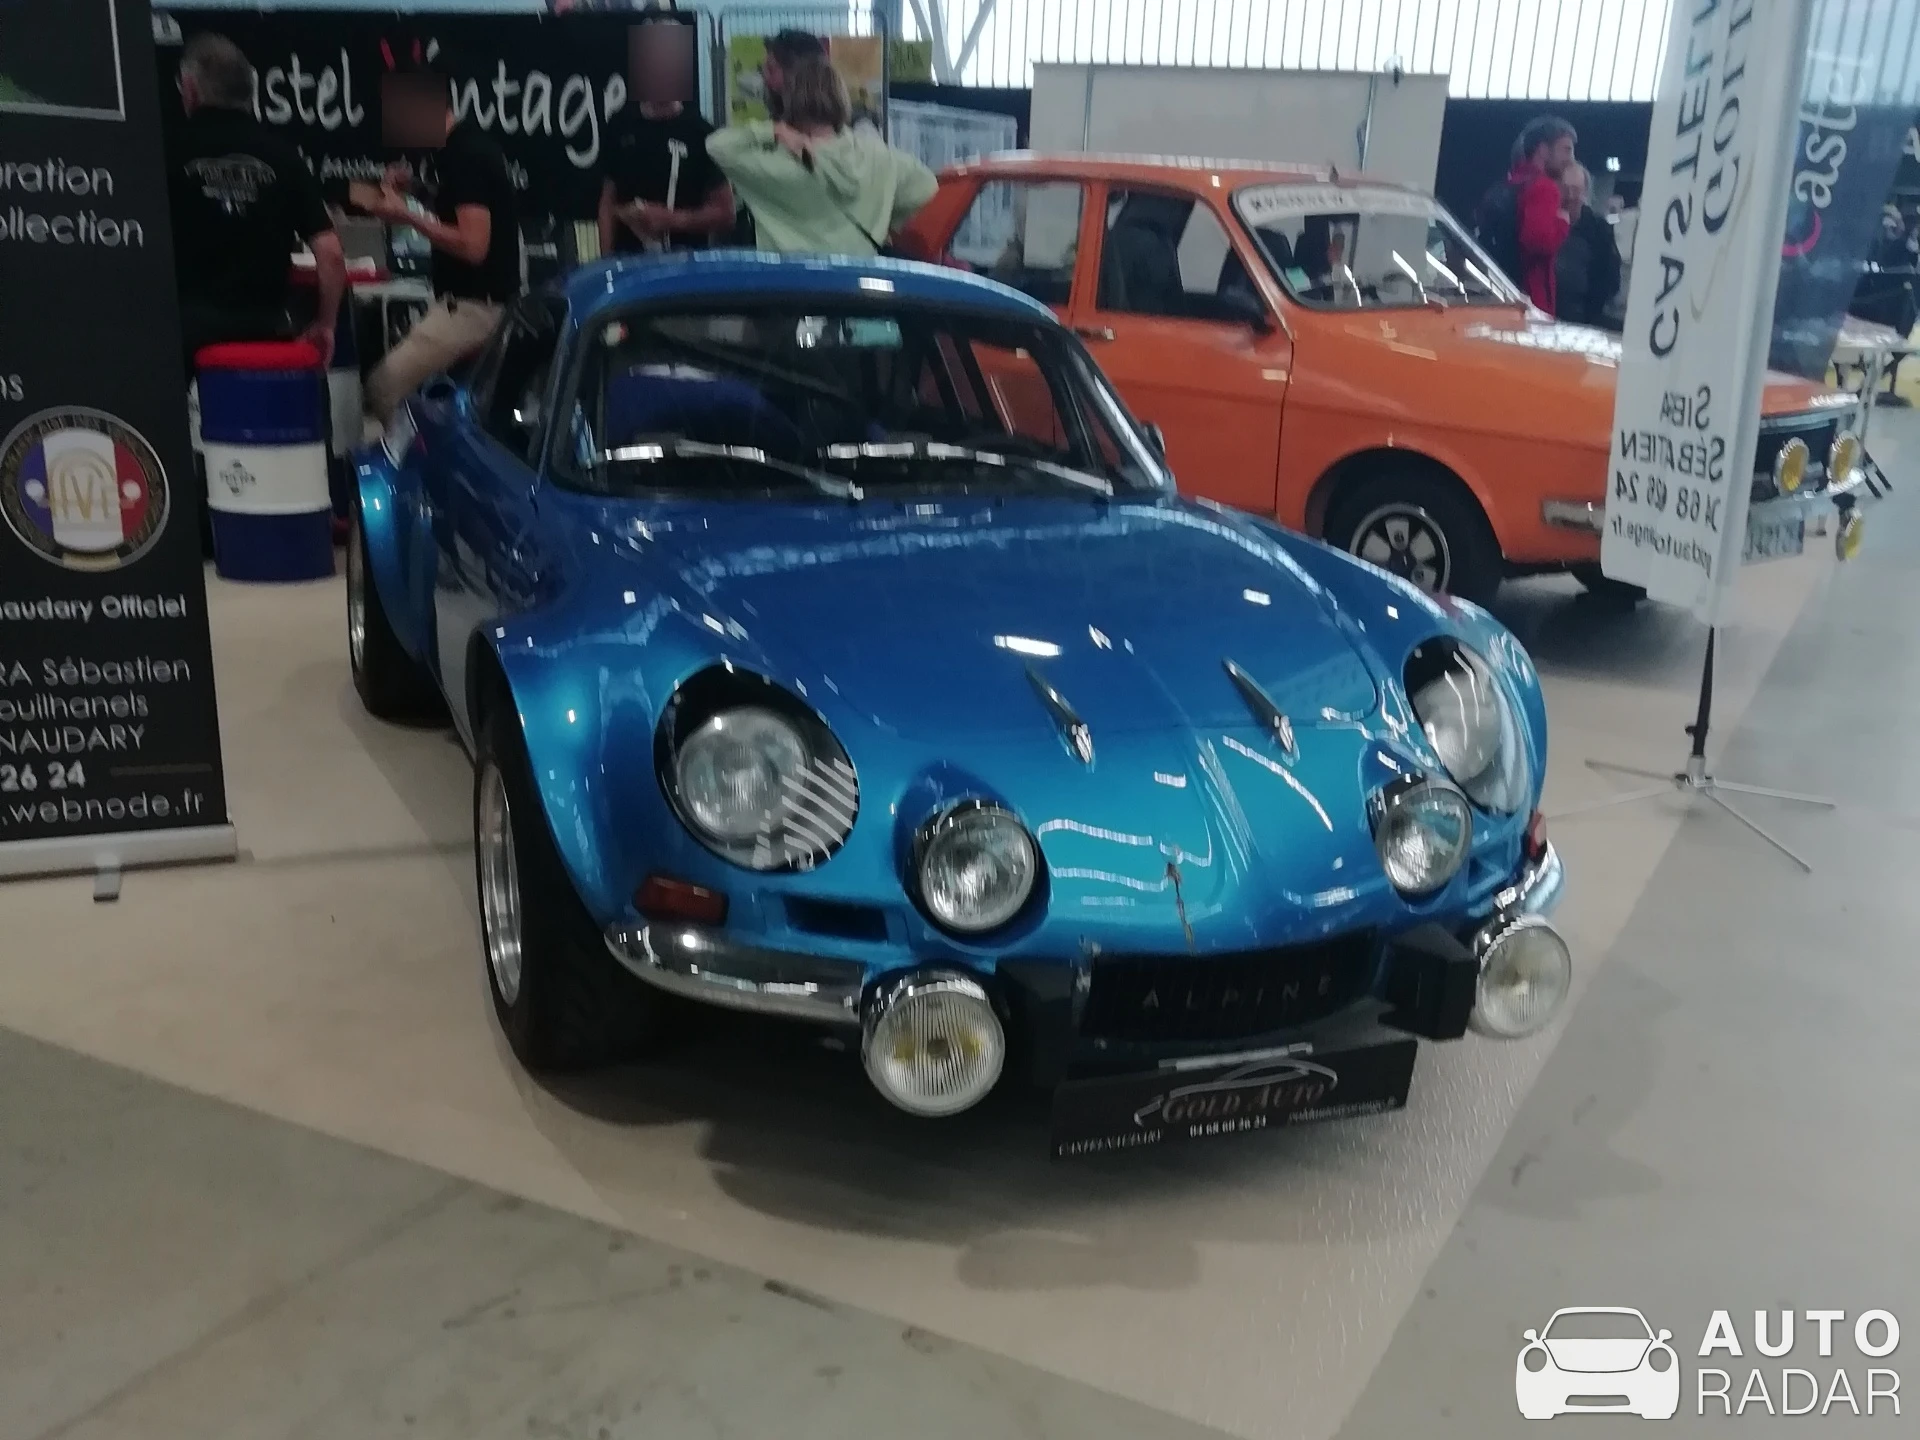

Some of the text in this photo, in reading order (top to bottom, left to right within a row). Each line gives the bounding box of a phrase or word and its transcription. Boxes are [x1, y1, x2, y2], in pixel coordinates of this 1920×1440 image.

[0, 157, 114, 197] ration
[0, 595, 94, 623] audary
[42, 654, 191, 687] Sébastien
[0, 758, 86, 792] 26 24
